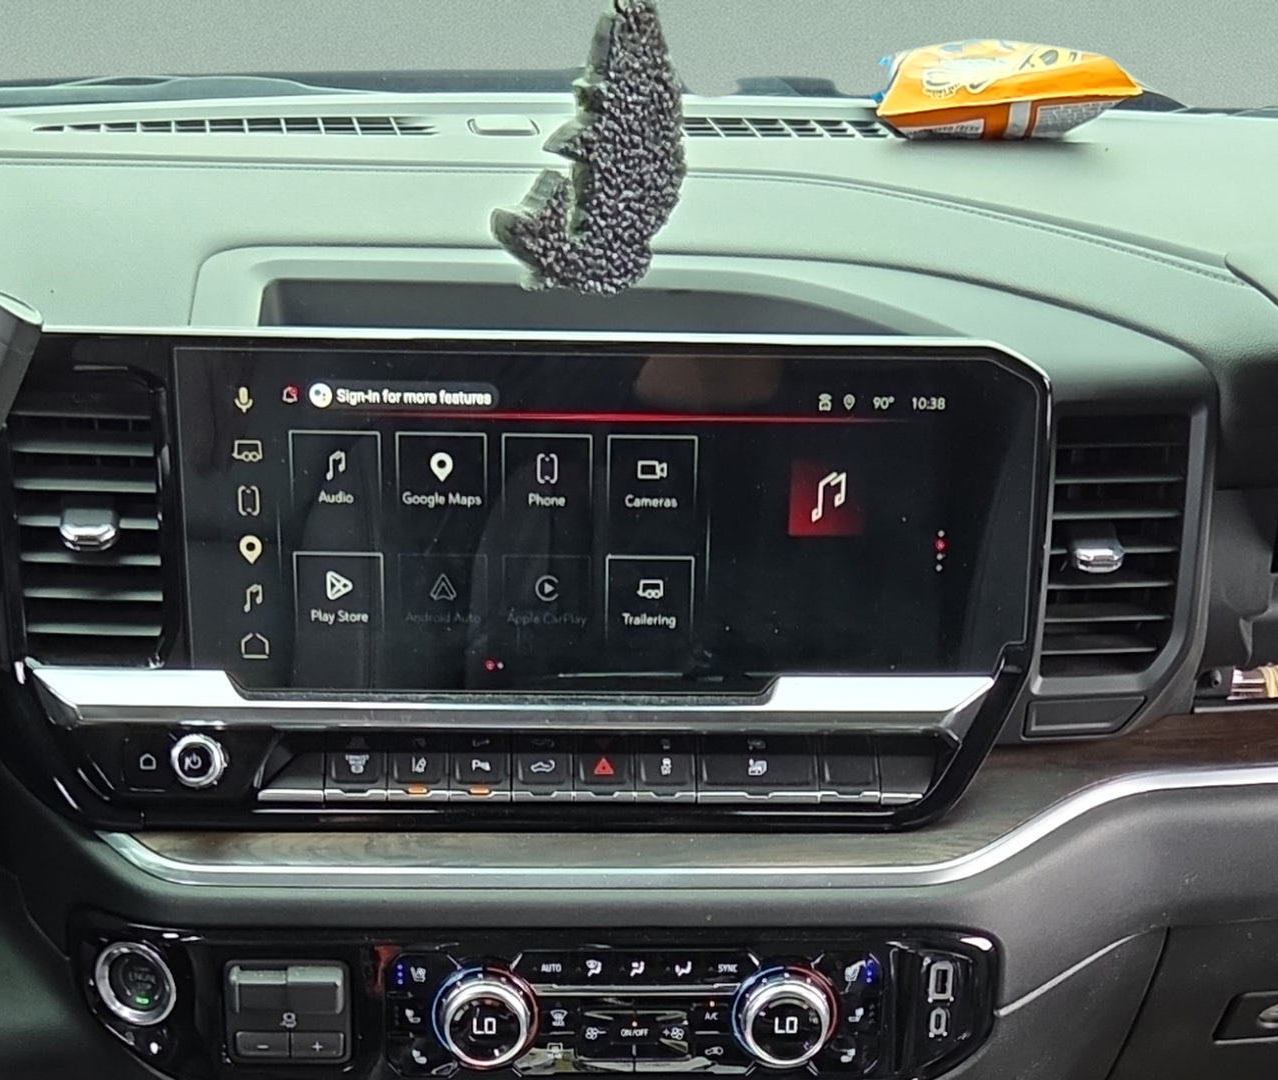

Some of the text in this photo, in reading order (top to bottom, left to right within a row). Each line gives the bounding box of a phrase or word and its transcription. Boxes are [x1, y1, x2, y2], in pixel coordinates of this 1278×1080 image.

[336, 388, 492, 406] Sign-in for more features
[912, 397, 946, 410] 10:38
[318, 490, 354, 504] Audio
[402, 491, 482, 508] Google Maps
[528, 493, 566, 507] Phone
[625, 494, 678, 508] Cameras
[310, 609, 369, 625] Play Store
[405, 612, 481, 624] Android Auto
[507, 612, 587, 627] Apple CarPlay
[622, 613, 676, 629] Trailering
[541, 963, 562, 973] AUTO
[717, 963, 739, 973] SYNC
[704, 1012, 719, 1021] A/C
[472, 1017, 497, 1036] LO
[620, 1028, 649, 1038] ON/OFF
[774, 1017, 798, 1035] LO
